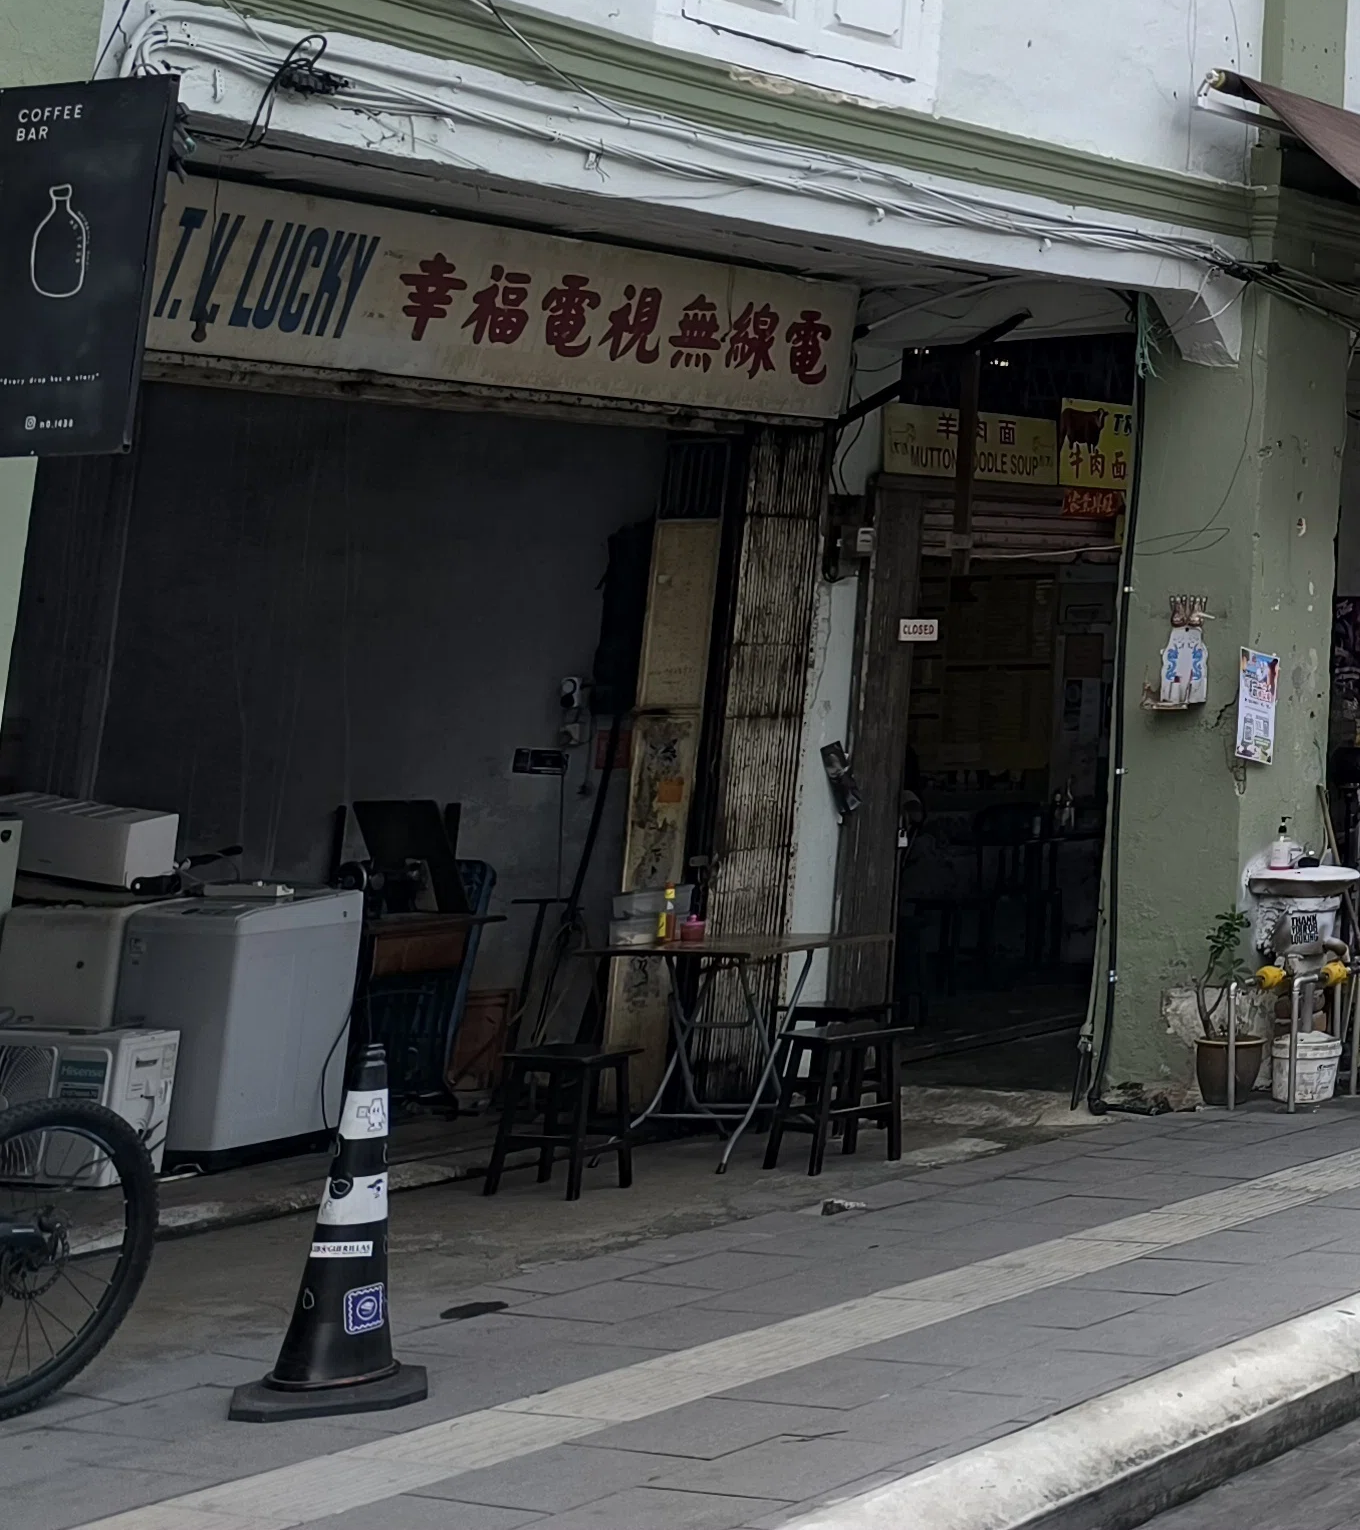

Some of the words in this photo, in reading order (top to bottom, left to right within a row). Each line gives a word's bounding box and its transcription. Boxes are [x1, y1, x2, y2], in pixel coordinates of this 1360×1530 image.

[18, 104, 84, 123] COFFEE
[16, 126, 49, 141] BAR
[228, 219, 381, 339] LUCKY
[399, 252, 832, 385] 幸福電視無線電
[1010, 455, 1039, 476] SOUP
[903, 624, 935, 635] CLOSED
